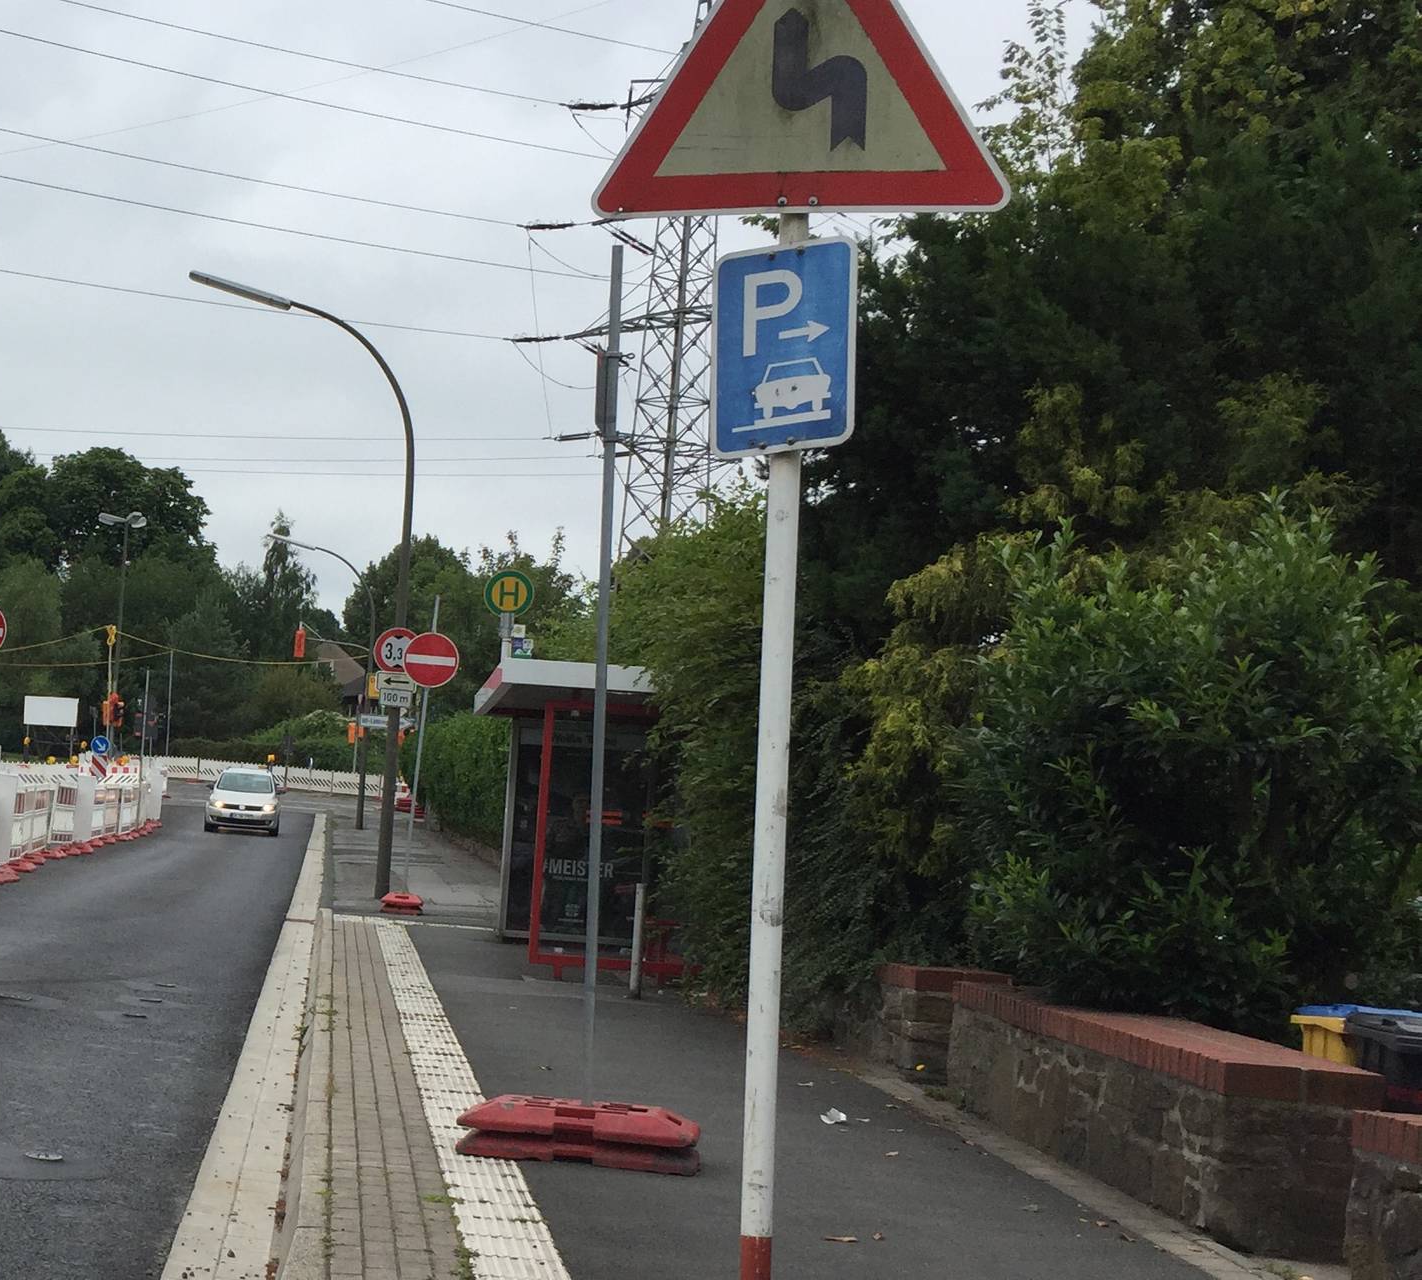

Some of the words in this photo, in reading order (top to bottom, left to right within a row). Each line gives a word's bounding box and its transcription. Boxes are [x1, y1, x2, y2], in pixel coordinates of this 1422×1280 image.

[743, 269, 803, 357] P
[499, 580, 520, 608] H
[383, 692, 398, 702] 100
[399, 695, 409, 703] m
